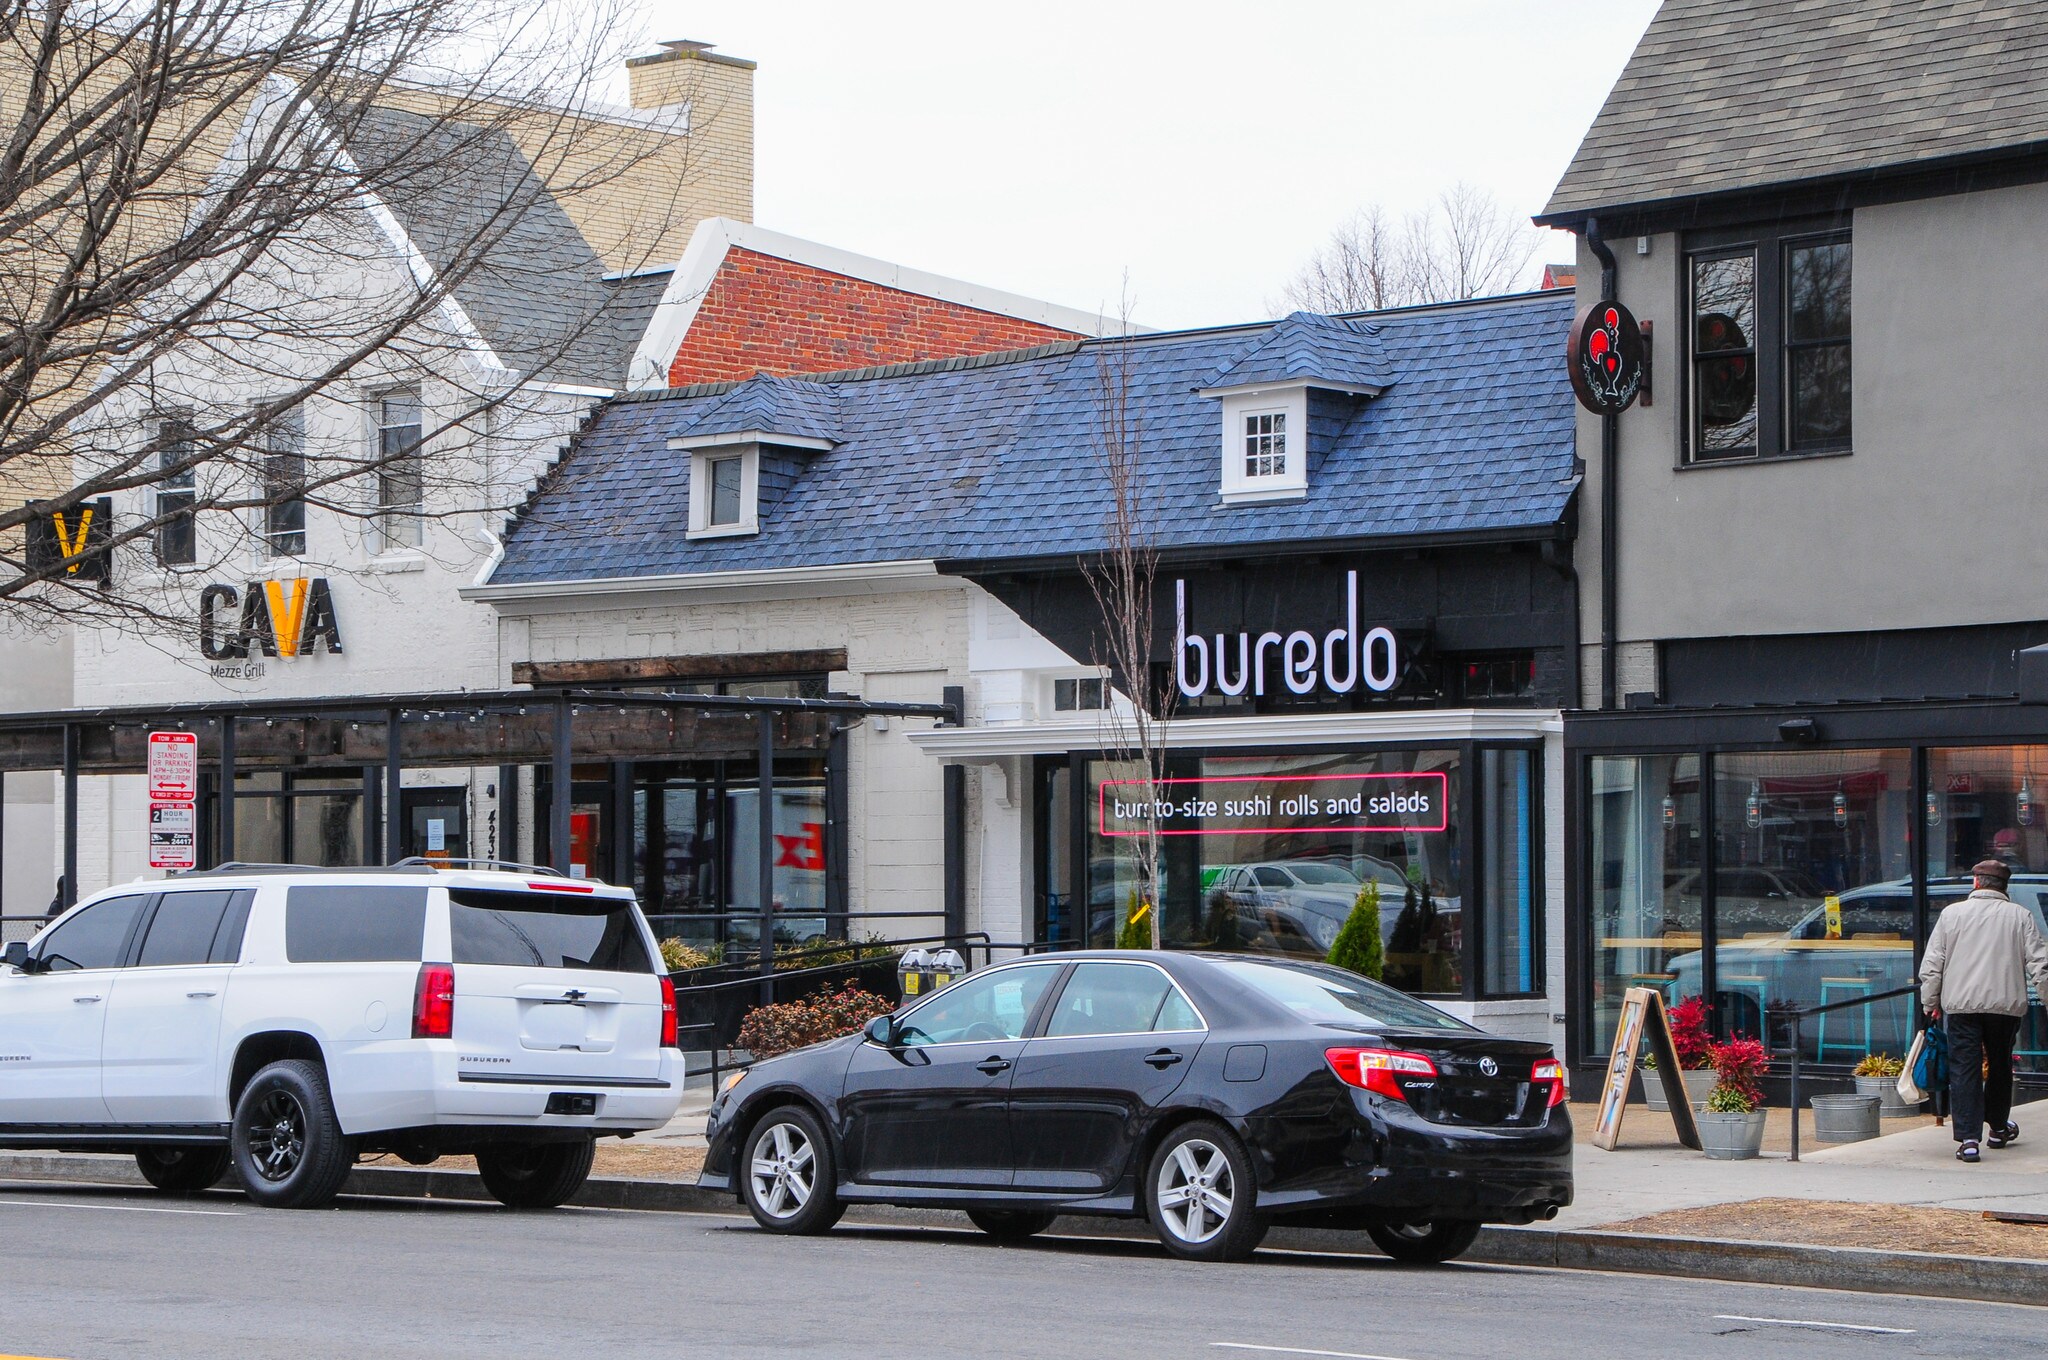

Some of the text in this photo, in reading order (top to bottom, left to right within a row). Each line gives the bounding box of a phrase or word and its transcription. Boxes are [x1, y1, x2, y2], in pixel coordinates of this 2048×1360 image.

[53, 509, 94, 573] V
[201, 577, 343, 660] CAVA
[1176, 570, 1398, 697] buredo
[210, 662, 266, 679] Mezze Grill
[156, 752, 189, 760] STANDING
[167, 743, 178, 752] NO
[164, 759, 193, 768] PARKING
[1114, 791, 1430, 819] burrto-size sushi rolls and salads
[153, 810, 160, 822] 2
